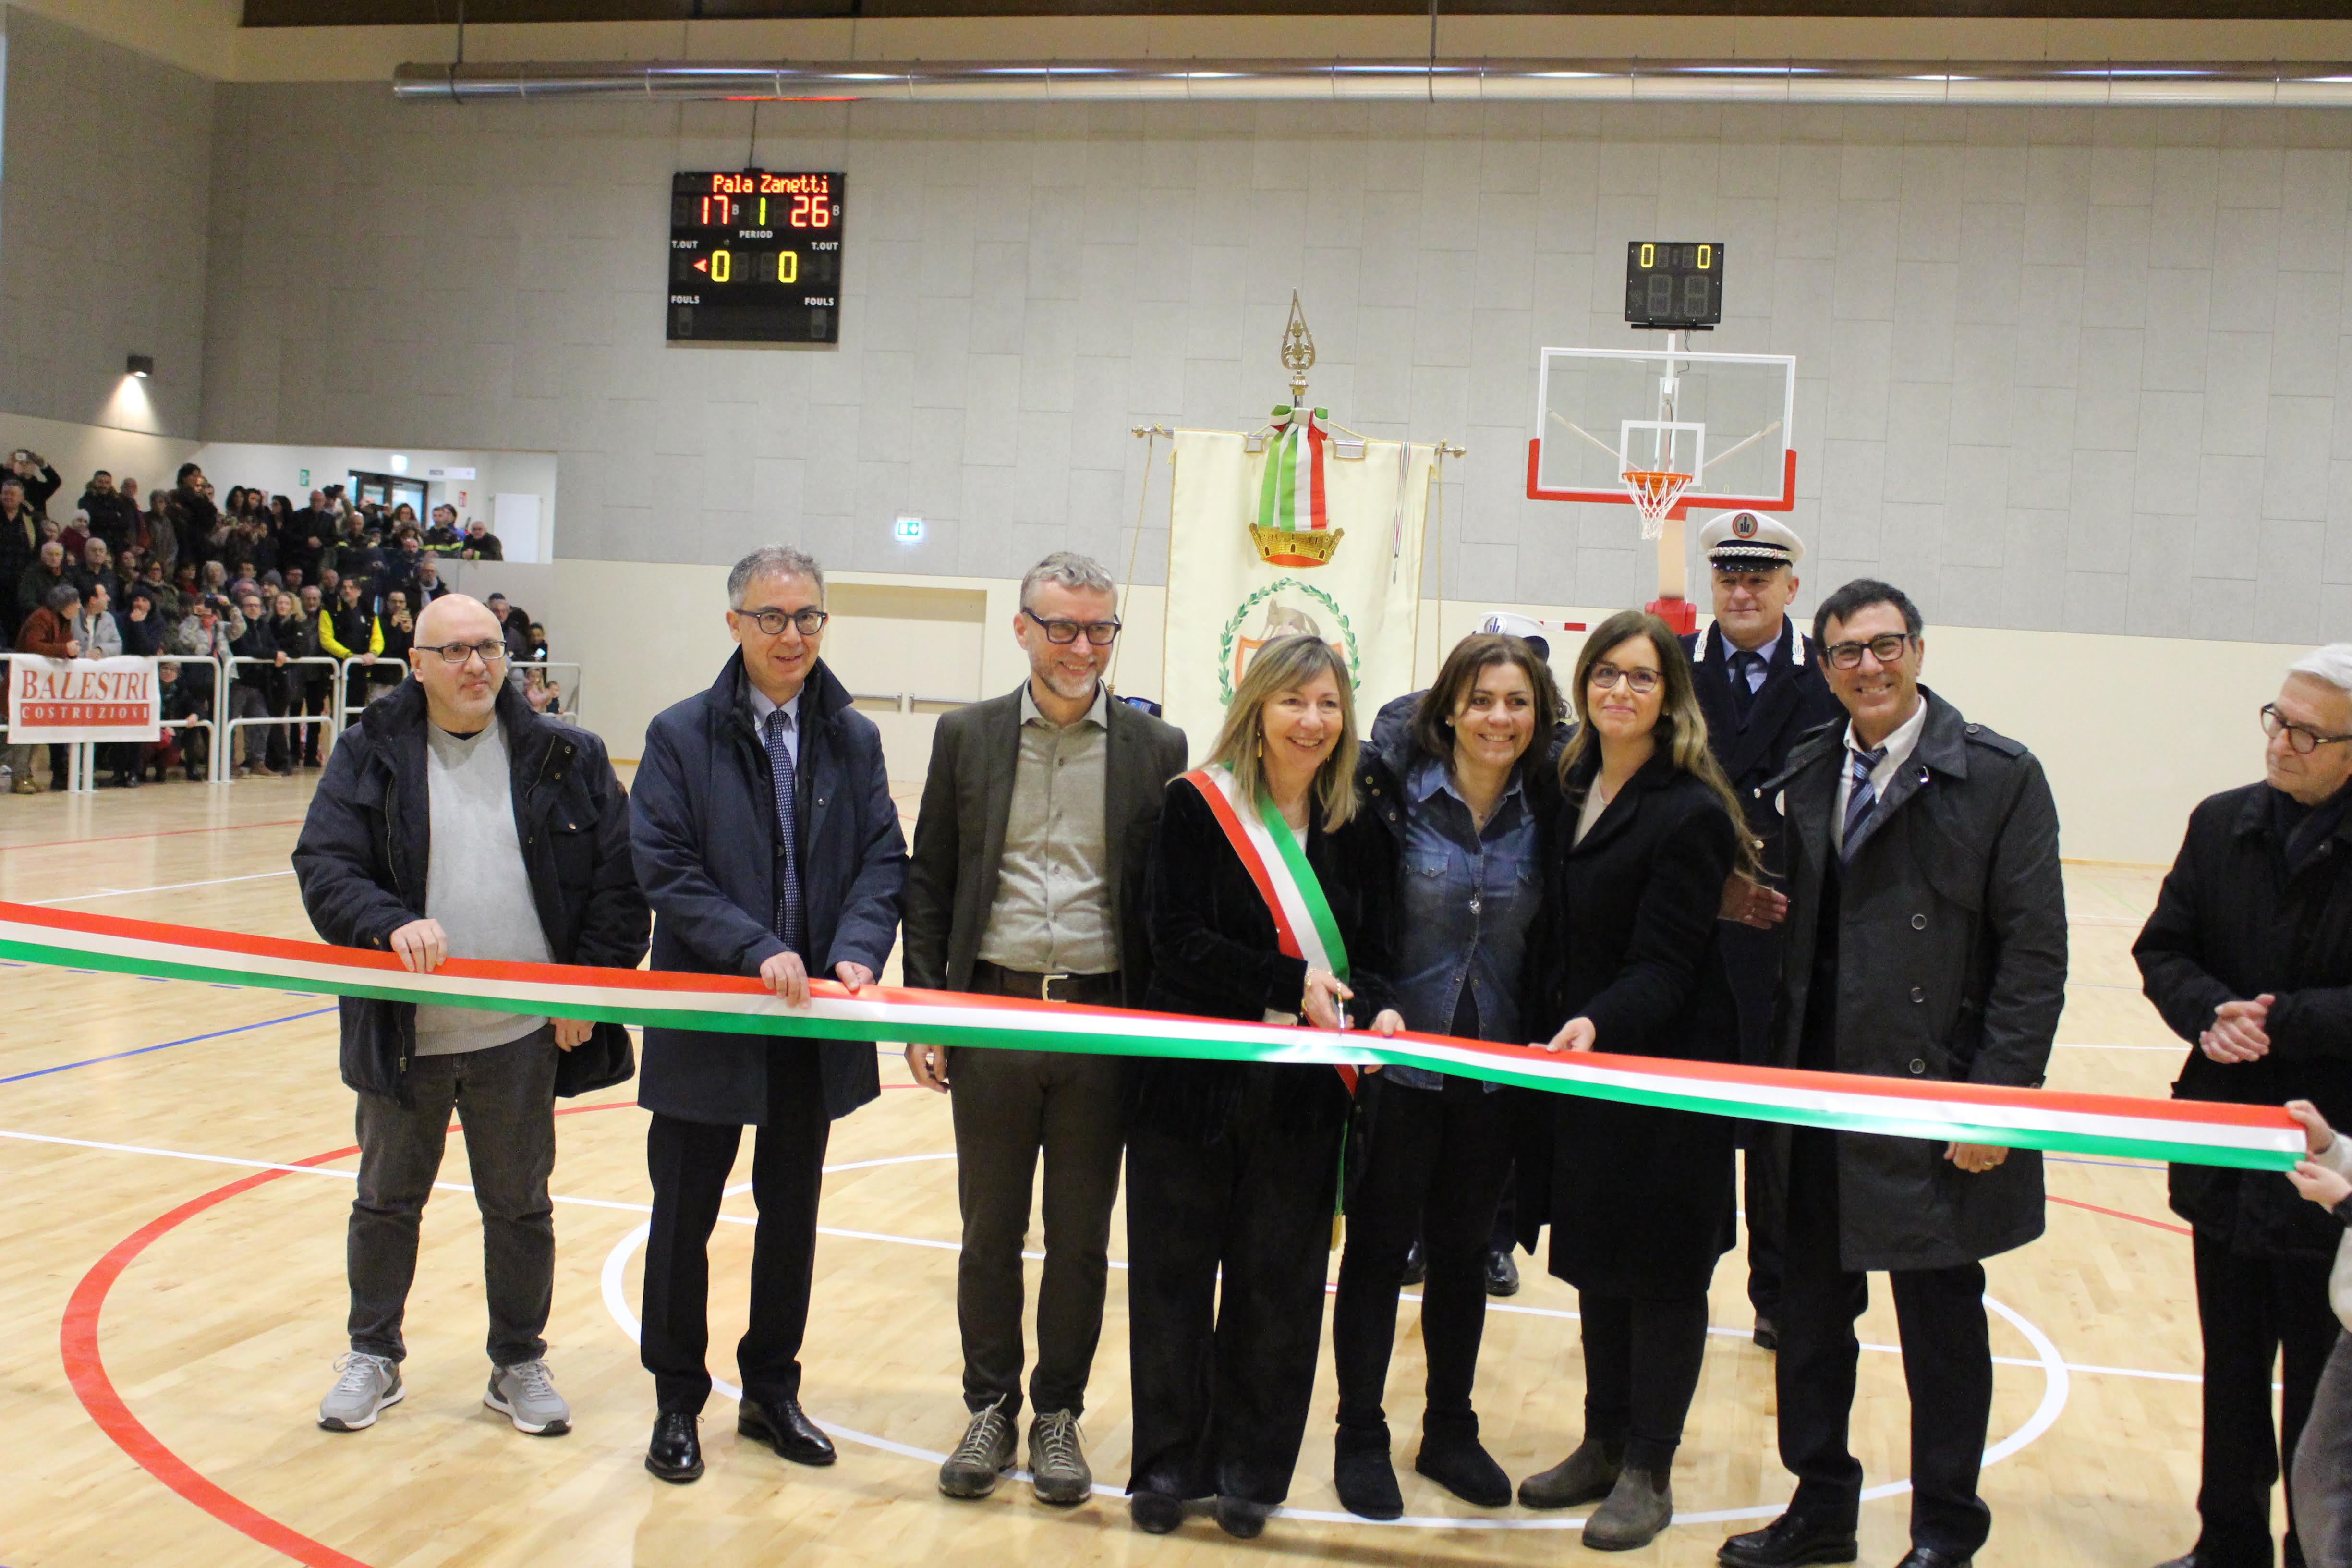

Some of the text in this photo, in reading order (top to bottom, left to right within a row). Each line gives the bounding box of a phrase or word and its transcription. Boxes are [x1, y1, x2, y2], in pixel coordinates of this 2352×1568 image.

[712, 174, 829, 193] Pala Zanetti
[702, 195, 729, 225] 17
[759, 196, 767, 226] 1
[790, 195, 829, 227] 26
[672, 240, 698, 249] T.OUT
[739, 230, 773, 239] PERIOD
[811, 241, 838, 251] T.OUT
[711, 249, 730, 282] 0
[778, 250, 798, 283] 0
[671, 295, 700, 304] FOULS
[804, 296, 835, 307] FOULS
[21, 670, 149, 700] BALESTRI
